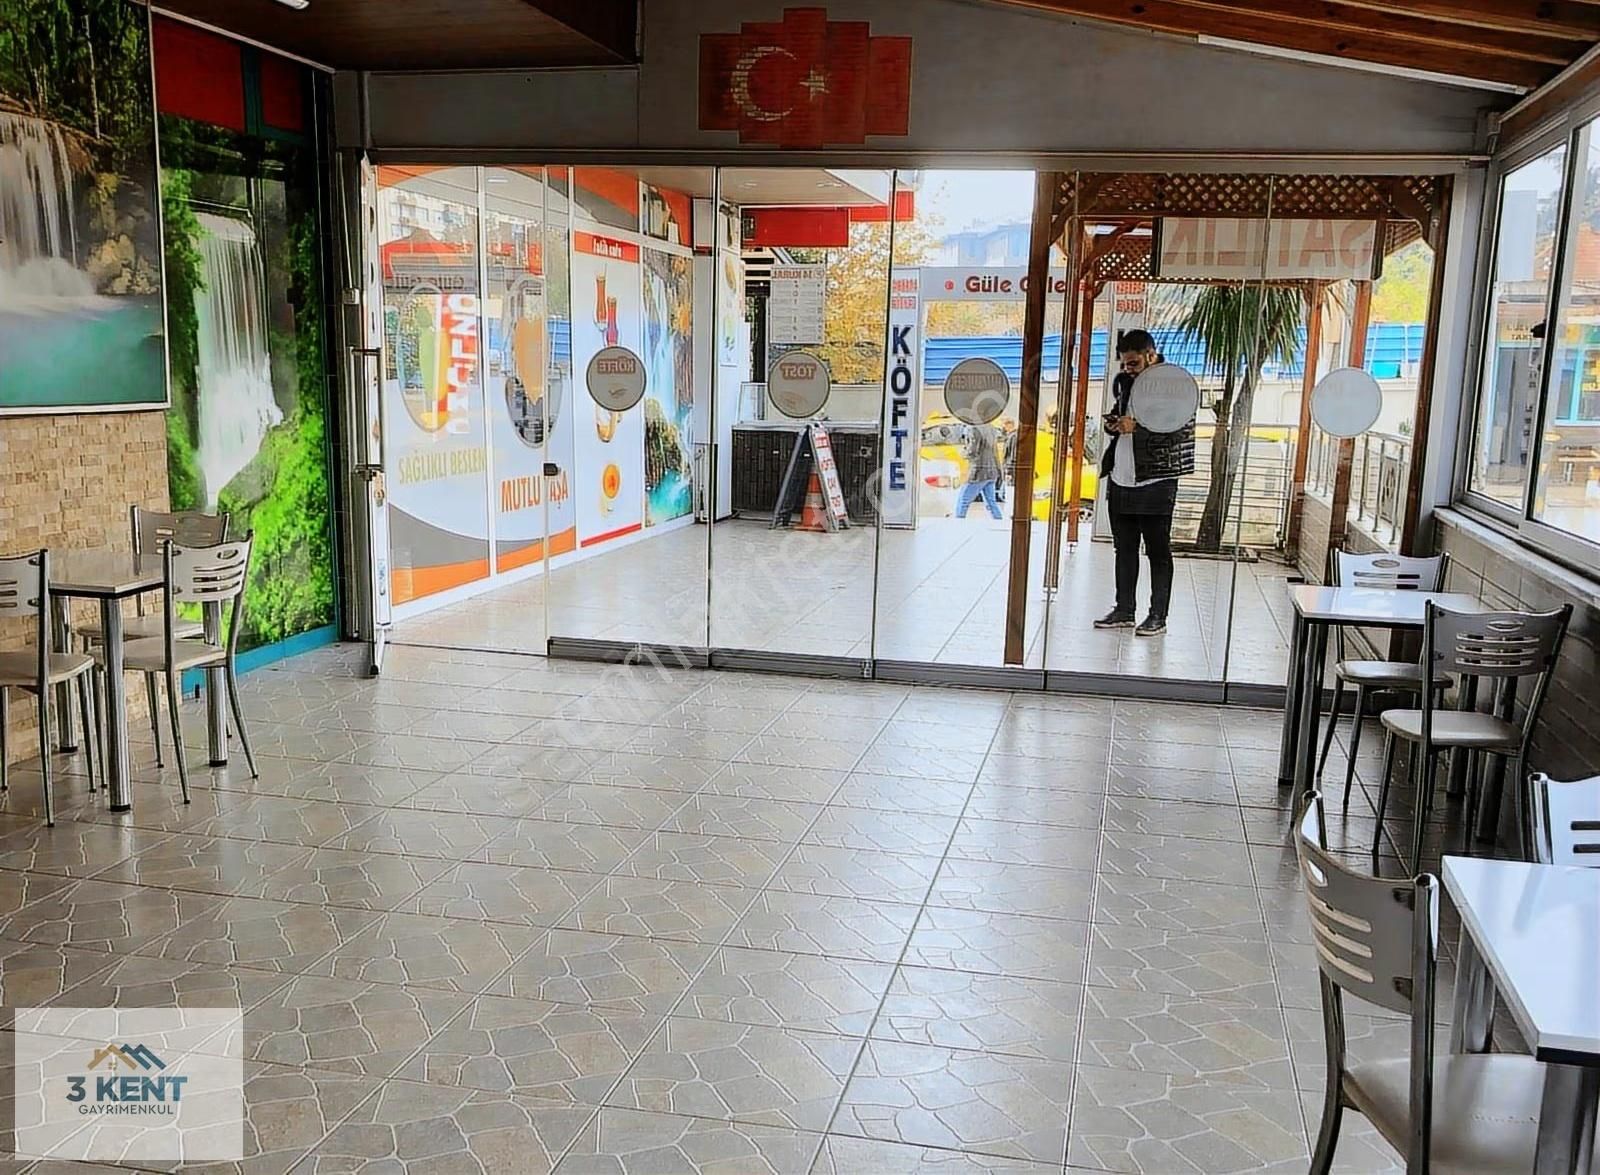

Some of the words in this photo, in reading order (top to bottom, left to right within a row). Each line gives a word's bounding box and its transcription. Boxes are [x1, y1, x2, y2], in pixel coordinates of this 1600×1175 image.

[965, 276, 1012, 293] Güle
[1019, 276, 1066, 293] Gle
[889, 324, 913, 491] KÖFTE
[398, 450, 447, 484] SAĞLIKLI
[501, 475, 541, 512] MUTLU
